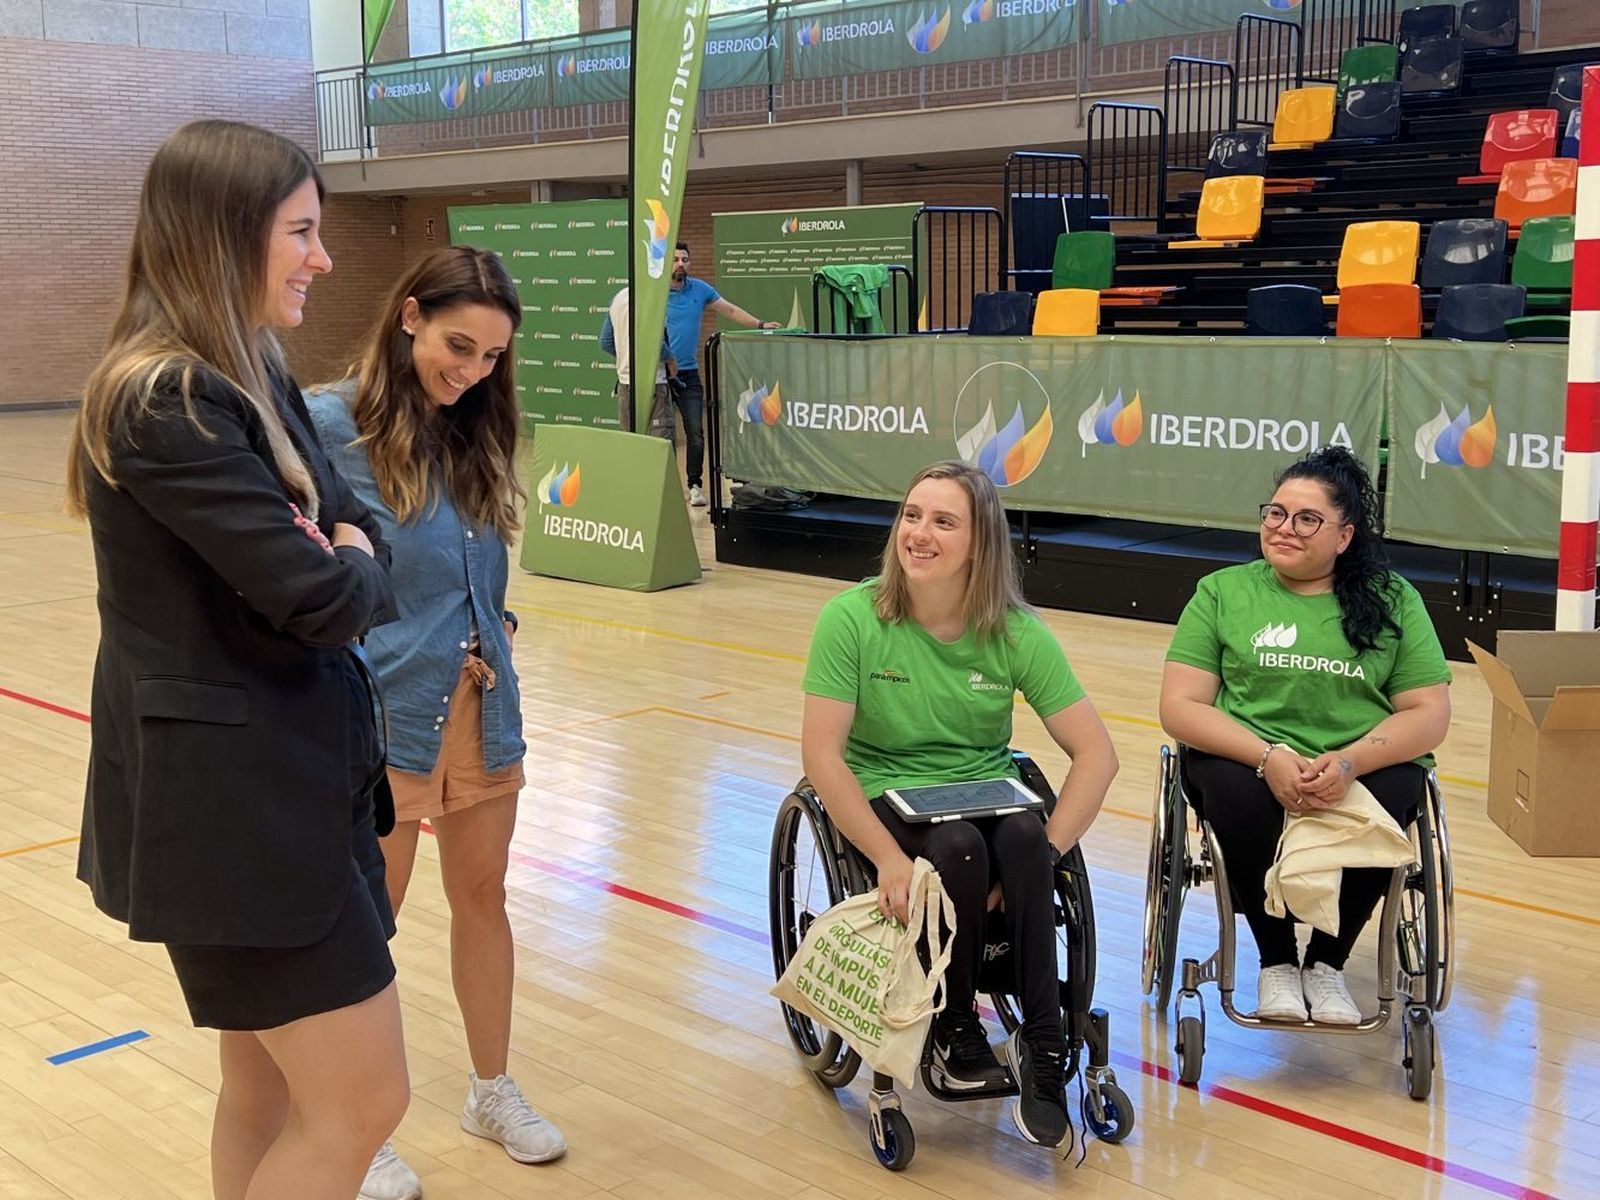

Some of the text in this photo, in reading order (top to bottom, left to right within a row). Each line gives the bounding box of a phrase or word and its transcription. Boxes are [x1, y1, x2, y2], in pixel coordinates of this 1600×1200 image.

[705, 35, 779, 55] IBERDROLA
[822, 19, 894, 42] IBERDROLA
[799, 220, 845, 231] IBERDROLA
[786, 400, 929, 435] IBERDROLA
[1150, 413, 1354, 455] IBERDROLA
[544, 514, 645, 553] IBERDROLA
[1259, 652, 1365, 680] IBERDROLA
[814, 936, 831, 956] DE
[804, 955, 816, 973] A
[816, 963, 834, 986] LA
[796, 975, 884, 1041] EN EL DEPORTE
